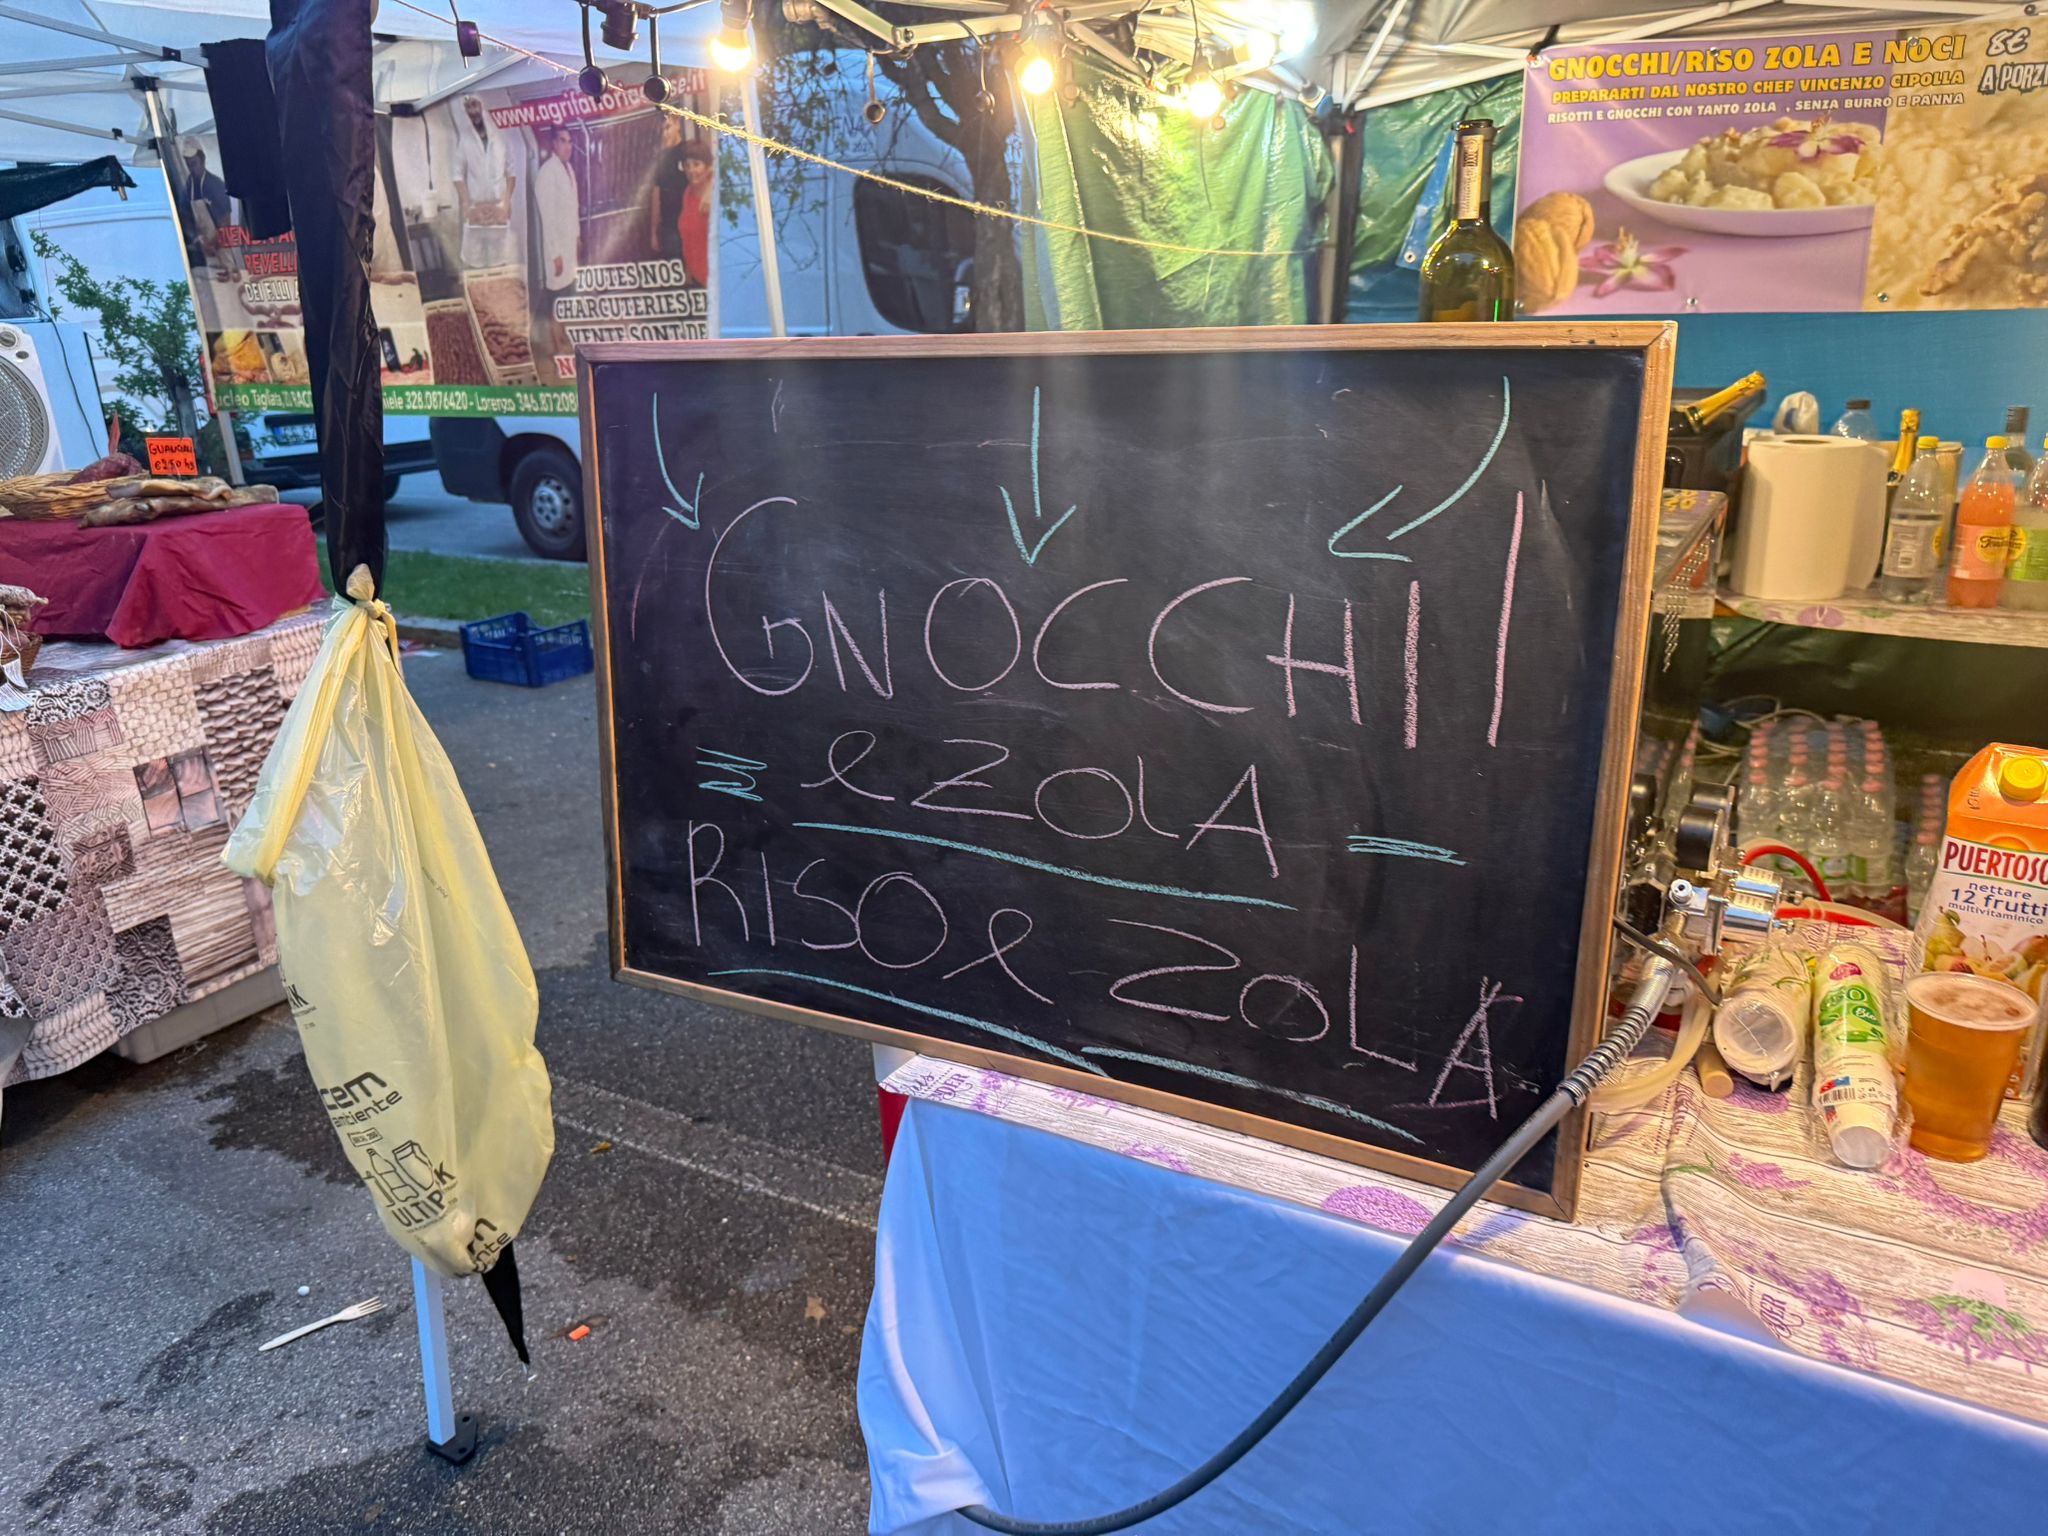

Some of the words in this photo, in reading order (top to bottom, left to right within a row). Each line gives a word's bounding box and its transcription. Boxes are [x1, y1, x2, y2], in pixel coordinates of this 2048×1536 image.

[1549, 47, 1755, 81] GNOCCHI/RISO
[1763, 44, 1841, 70] ZOLA
[1852, 42, 1872, 66] E
[1883, 34, 1967, 64] NOCI
[1552, 86, 1645, 105] PREPARARTI
[1650, 85, 1680, 99] DAL
[1684, 81, 1747, 97] NOSTRO
[1752, 79, 1794, 94] CHEF
[1799, 75, 1885, 92] VINCENZO
[1890, 70, 1965, 89] CIPOLLA
[1978, 64, 1998, 94] A
[1547, 110, 1593, 124] RISOTTI
[1596, 109, 1604, 121] E
[1606, 106, 1662, 121] GNOCCHI
[1666, 104, 1693, 117] CON
[1697, 103, 1740, 116] TANTO
[1743, 101, 1777, 113] ZOLA
[1795, 100, 1838, 112] SENZA
[1844, 97, 1892, 109] BURRO
[1896, 95, 1906, 107] E
[1910, 93, 1964, 107] PANNA
[576, 264, 639, 289] TOUTES
[640, 261, 684, 285] NOS
[556, 292, 689, 320] CHARCUTERIES
[911, 739, 1279, 878] ZOLA
[1952, 887, 1976, 905] 12
[1983, 895, 2048, 917] frutti
[1969, 882, 2032, 900] nettare
[1948, 902, 2044, 925] multivitaminico
[688, 820, 948, 968] RISO
[1108, 918, 1503, 1121] ZOLA
